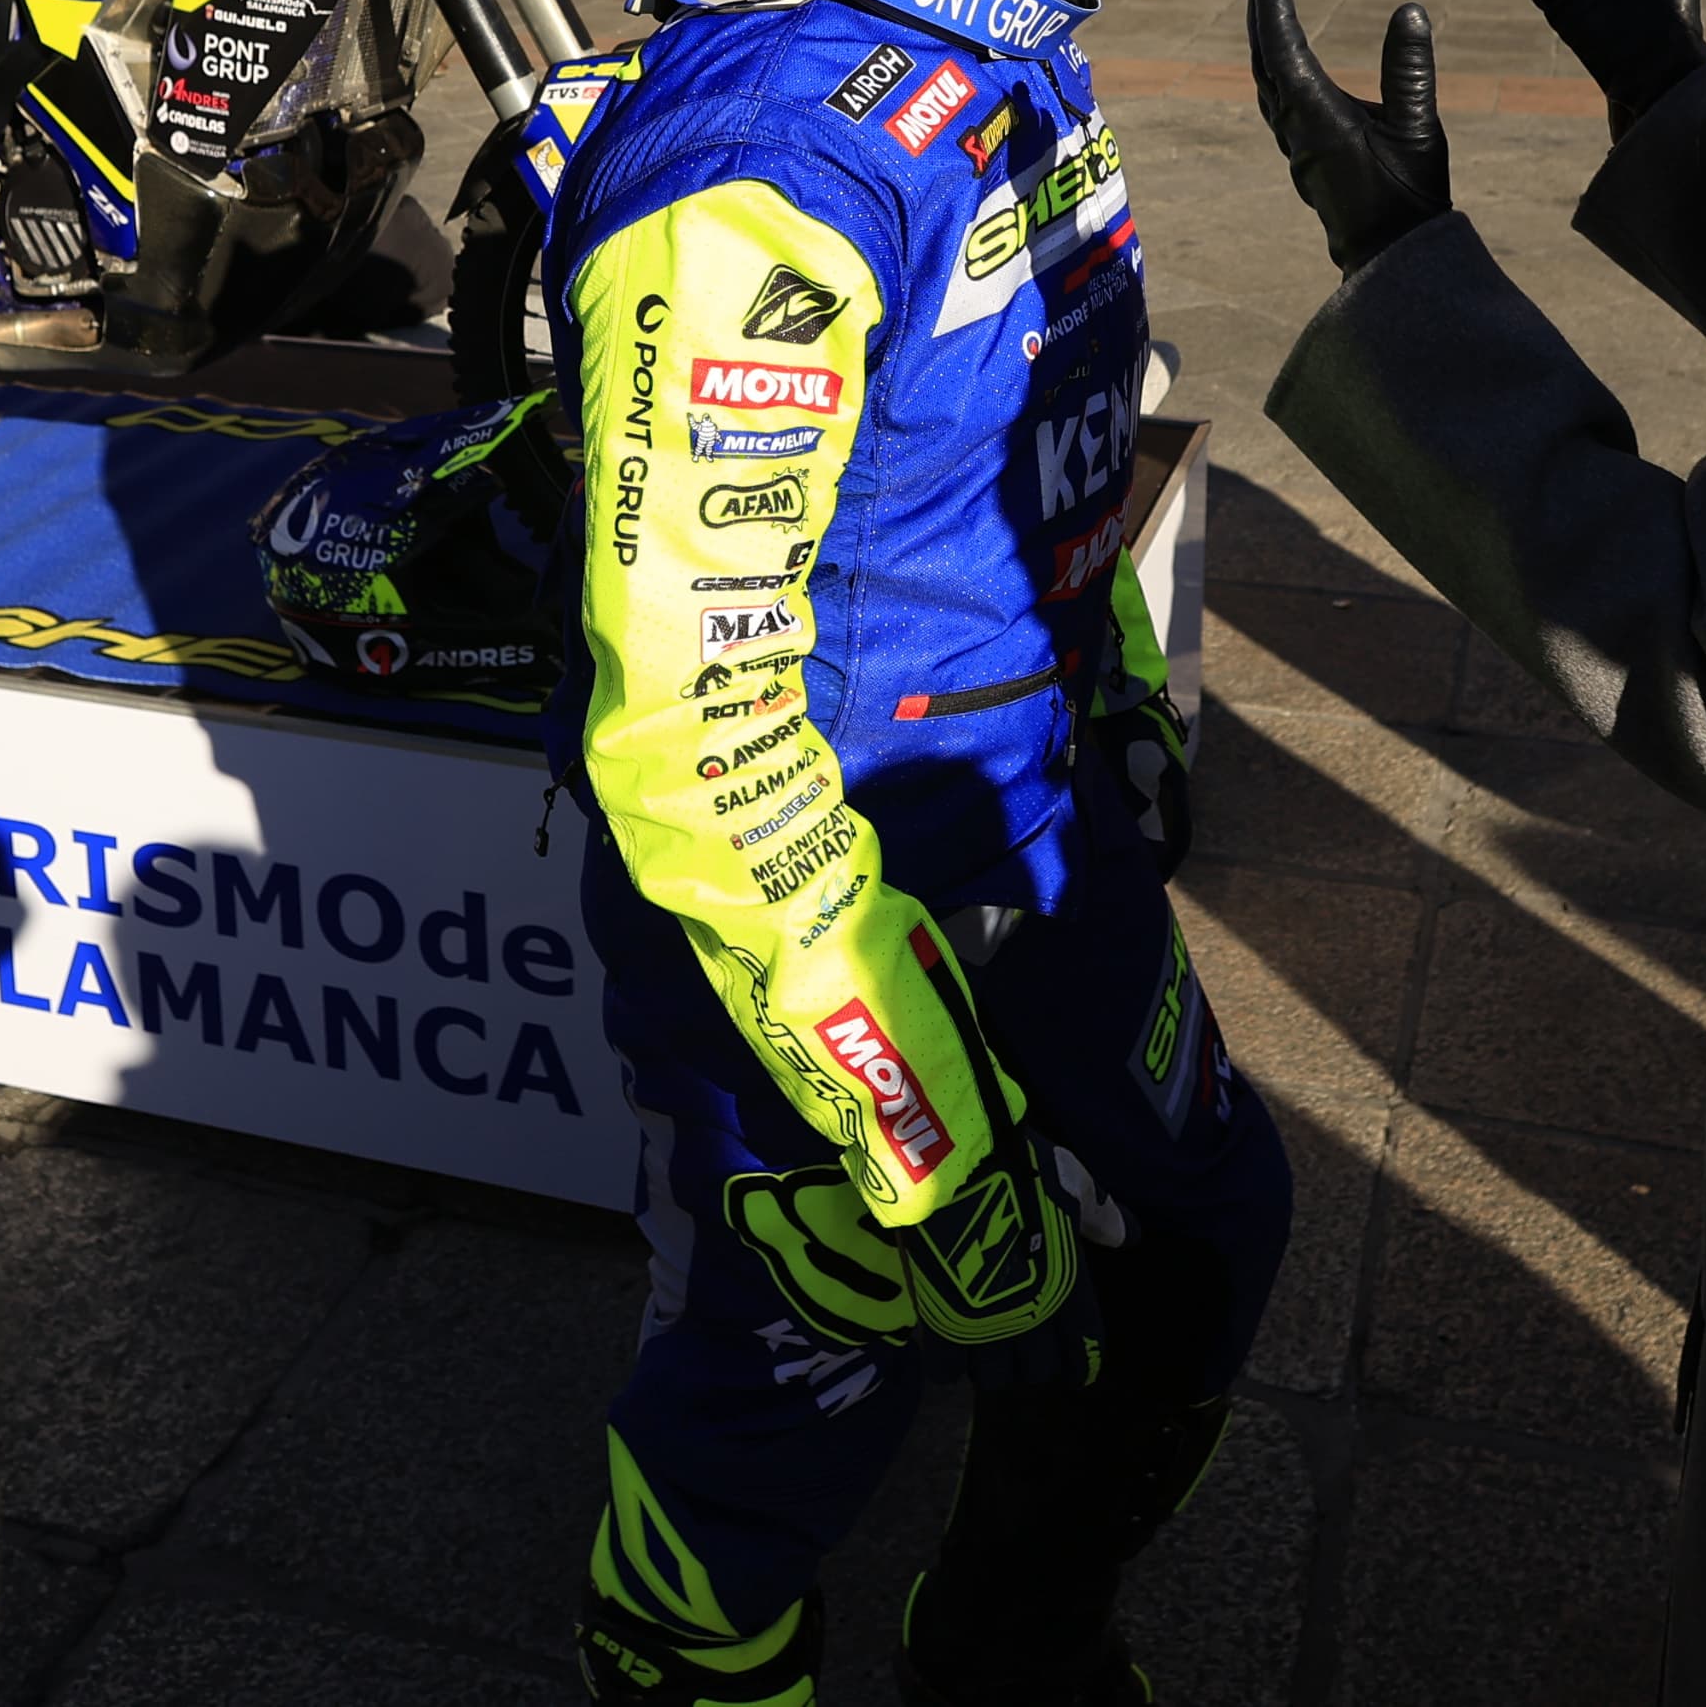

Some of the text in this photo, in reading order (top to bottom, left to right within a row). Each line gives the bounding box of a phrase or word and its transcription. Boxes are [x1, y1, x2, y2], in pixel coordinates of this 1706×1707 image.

[214, 9, 287, 33] GUIJUELO
[204, 33, 270, 63] PONT
[202, 54, 270, 85] GRUP
[842, 46, 905, 113] AIROH
[547, 88, 579, 100] TVS
[895, 69, 969, 149] MOTUL
[169, 110, 226, 135] CANDELAS
[699, 366, 831, 408] MOTUL
[440, 428, 493, 454] AIROH
[613, 341, 657, 567] PONT GRUP
[722, 429, 819, 452] MICHELIN
[720, 488, 795, 518] AFAM
[323, 513, 387, 544] PONT
[315, 540, 387, 571] GRUP
[744, 783, 824, 846] GUIJUELO
[757, 821, 859, 905] MUNTADA
[825, 1016, 941, 1168] MOTUL
